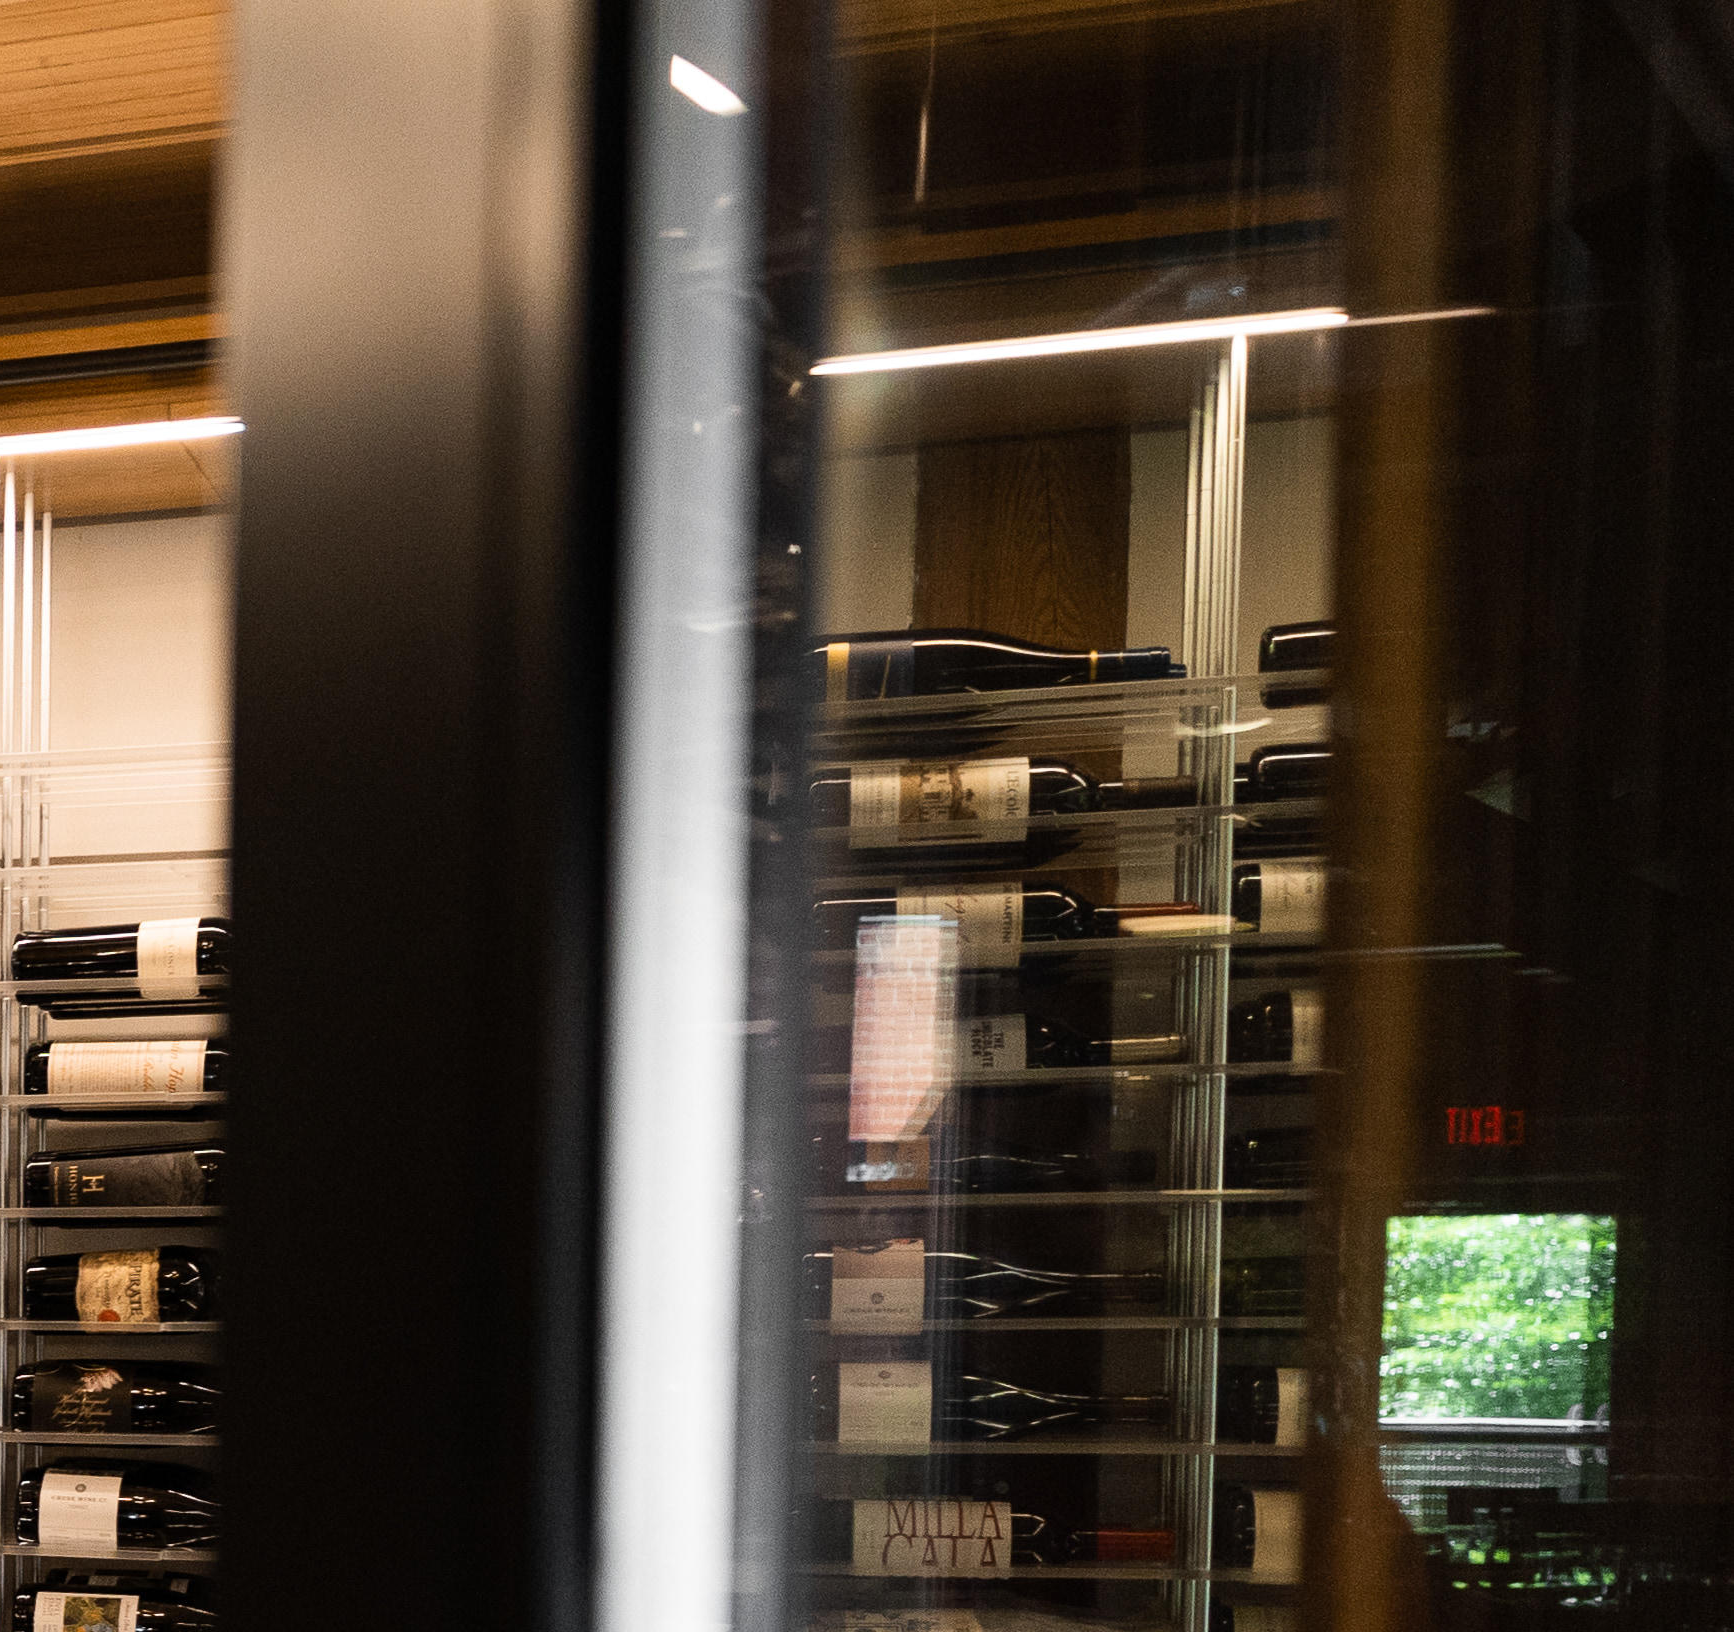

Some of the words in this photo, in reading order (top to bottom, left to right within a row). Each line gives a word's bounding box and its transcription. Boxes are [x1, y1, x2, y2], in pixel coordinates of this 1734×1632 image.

[164, 1062, 186, 1094] Hop
[125, 1264, 143, 1317] PIRATE
[883, 1499, 1005, 1540] MILLA
